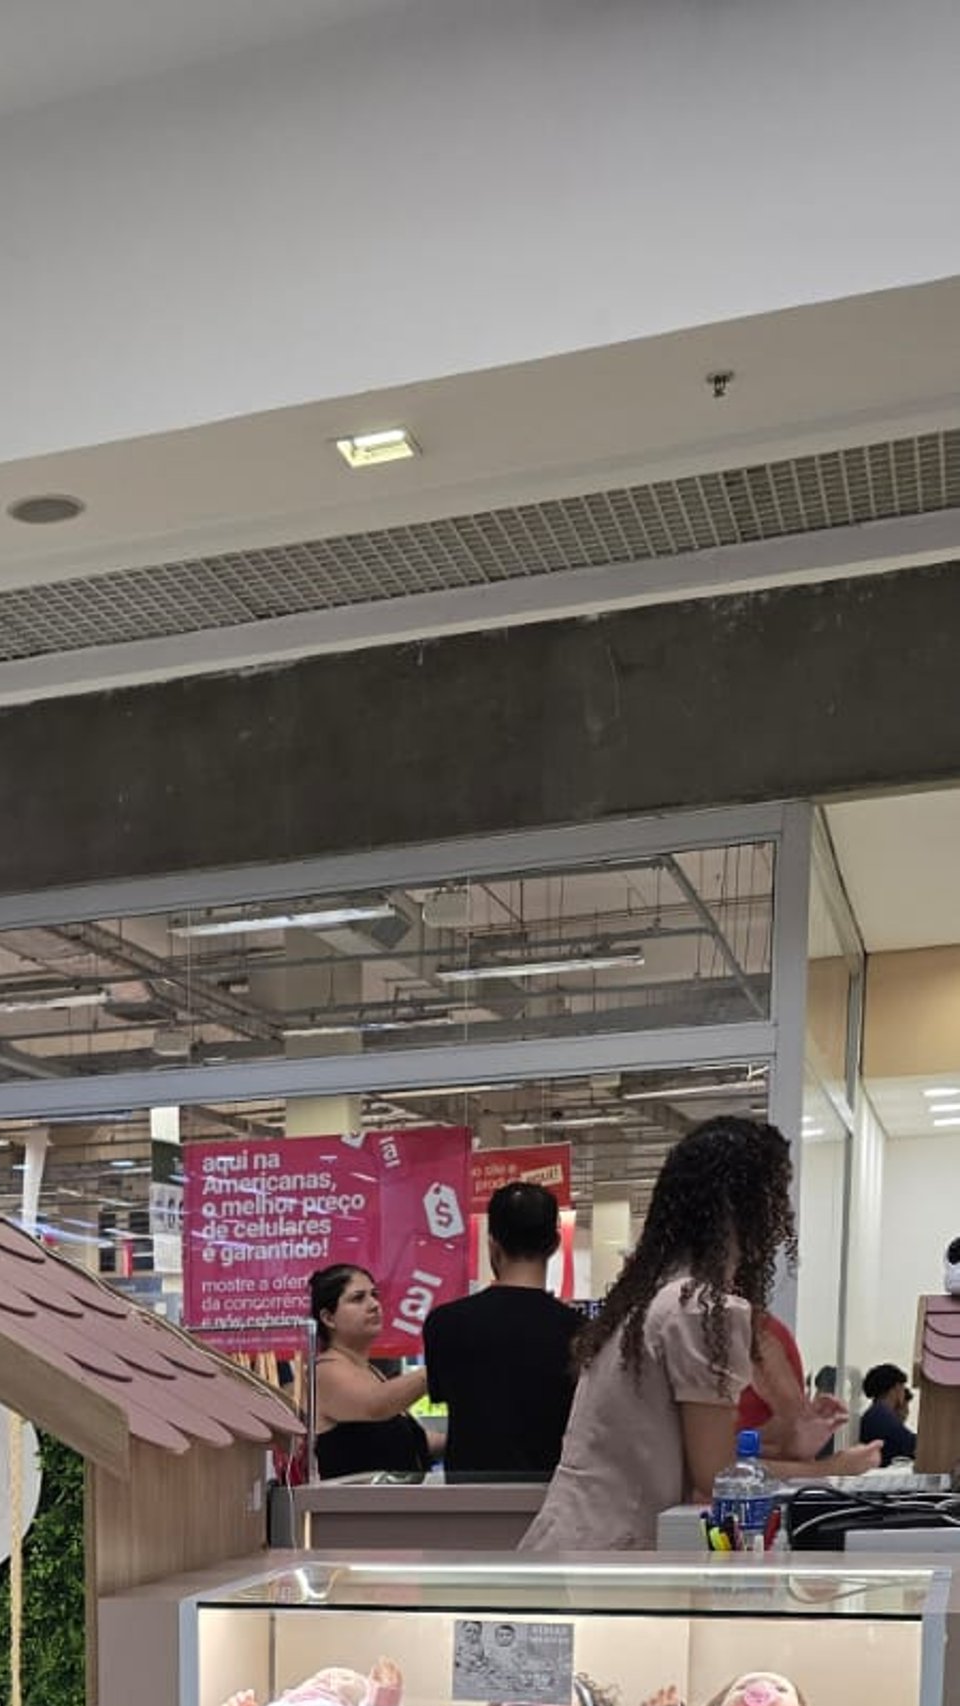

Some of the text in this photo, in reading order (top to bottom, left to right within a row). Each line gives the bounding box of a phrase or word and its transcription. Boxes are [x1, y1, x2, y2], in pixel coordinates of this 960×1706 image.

[202, 1150, 249, 1176] aqui
[253, 1153, 280, 1170] na
[202, 1171, 337, 1196] Americanas,
[202, 1202, 217, 1217] o
[221, 1194, 295, 1217] melhor
[302, 1192, 366, 1217] preço
[202, 1216, 332, 1240] de celulares
[221, 1238, 329, 1266] garantido!
[202, 1277, 255, 1292] mostre
[259, 1278, 270, 1290] a
[202, 1291, 312, 1311] da concorrênc
